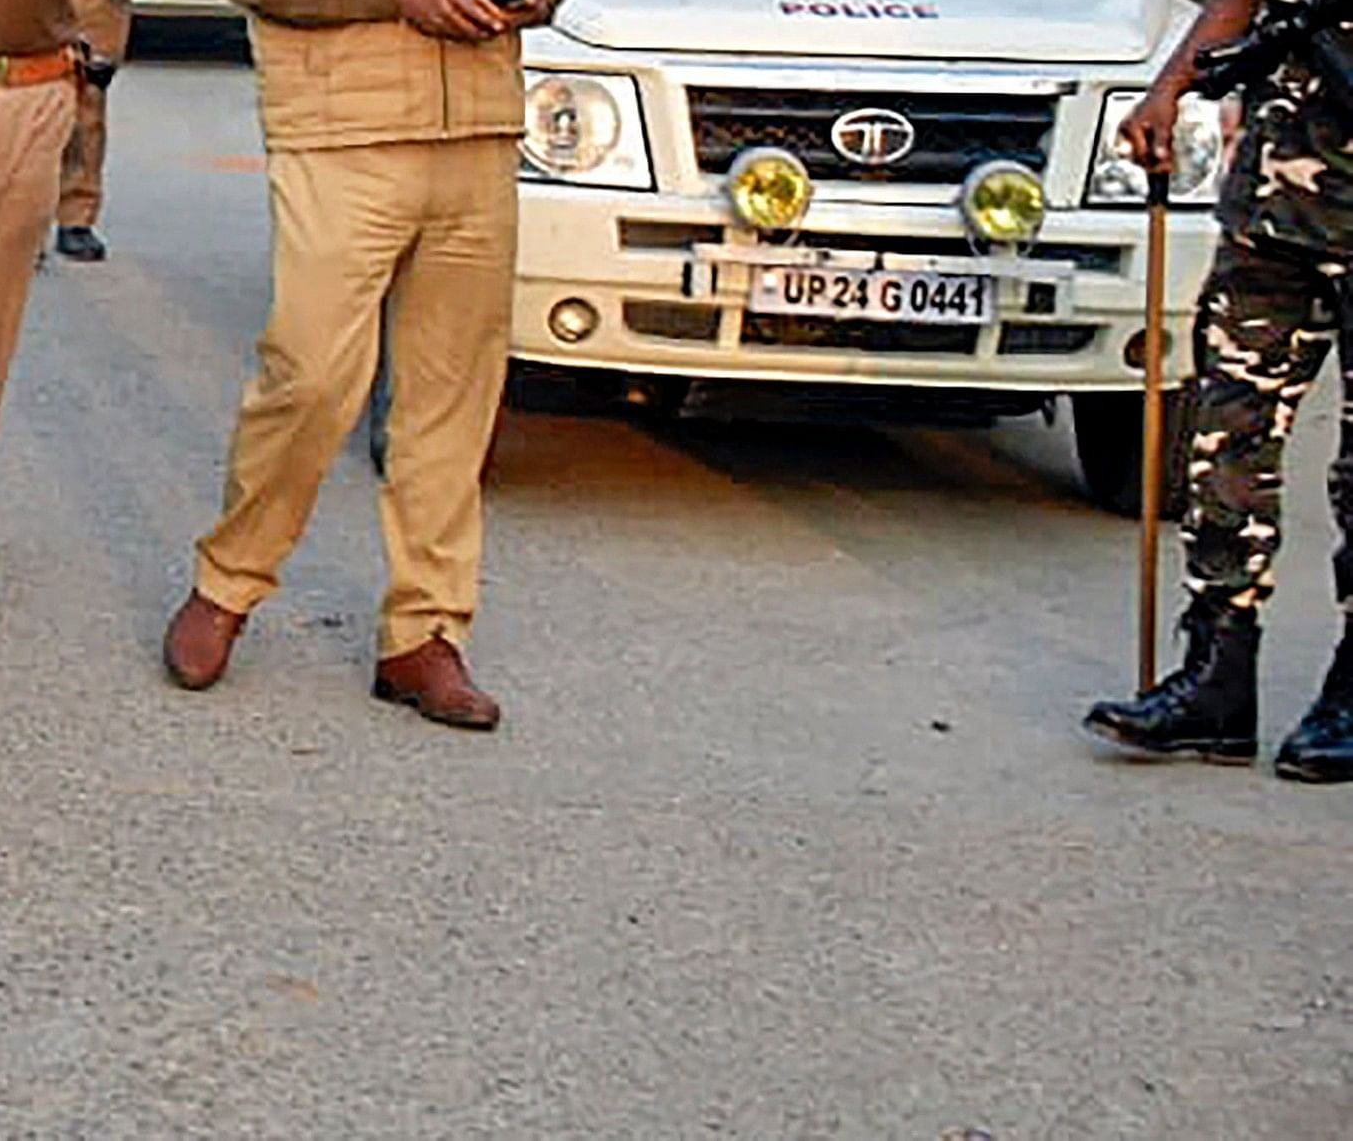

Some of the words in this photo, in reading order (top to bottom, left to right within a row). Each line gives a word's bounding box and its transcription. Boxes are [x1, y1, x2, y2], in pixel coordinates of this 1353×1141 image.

[779, 2, 940, 20] POLICE
[881, 280, 902, 312] G
[910, 278, 984, 315] 0441
